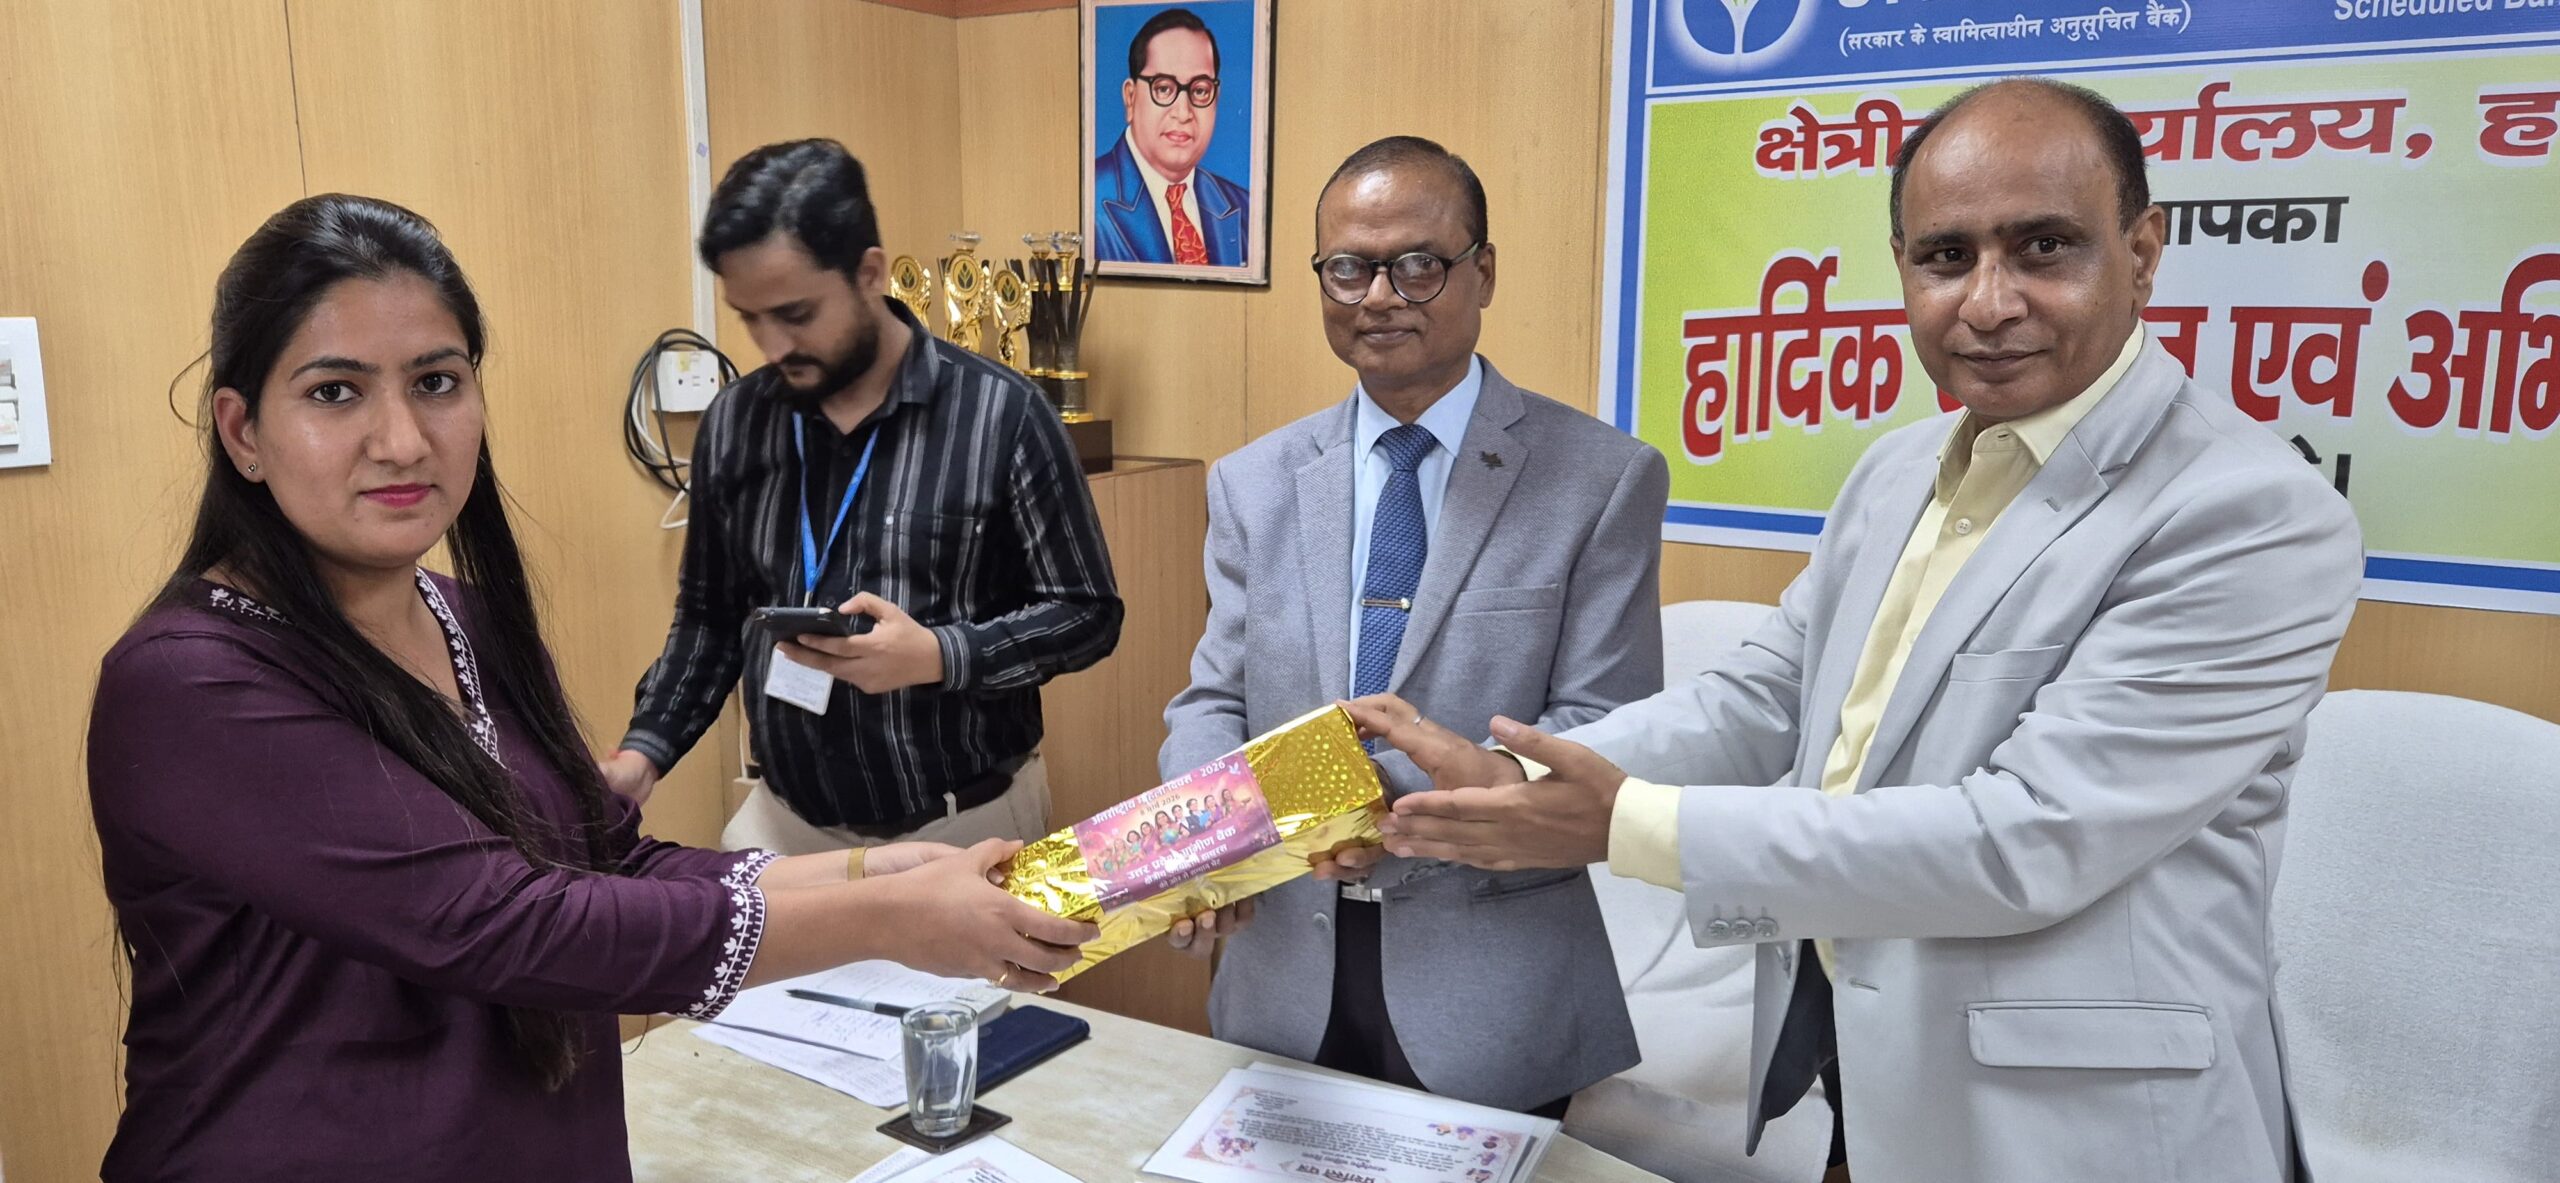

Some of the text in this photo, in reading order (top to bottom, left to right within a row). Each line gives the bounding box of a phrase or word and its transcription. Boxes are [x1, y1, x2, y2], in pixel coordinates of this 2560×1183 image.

[1839, 0, 2192, 57] (सरकार के स्वामित्वाधीन अनुसूचित बैंक)
[1756, 99, 1926, 172] क्षेत्री
[1683, 255, 1910, 457] हार्दिक
[2230, 260, 2389, 422] एवं
[1200, 761, 1226, 777] 2026
[1160, 794, 1181, 809] 2026
